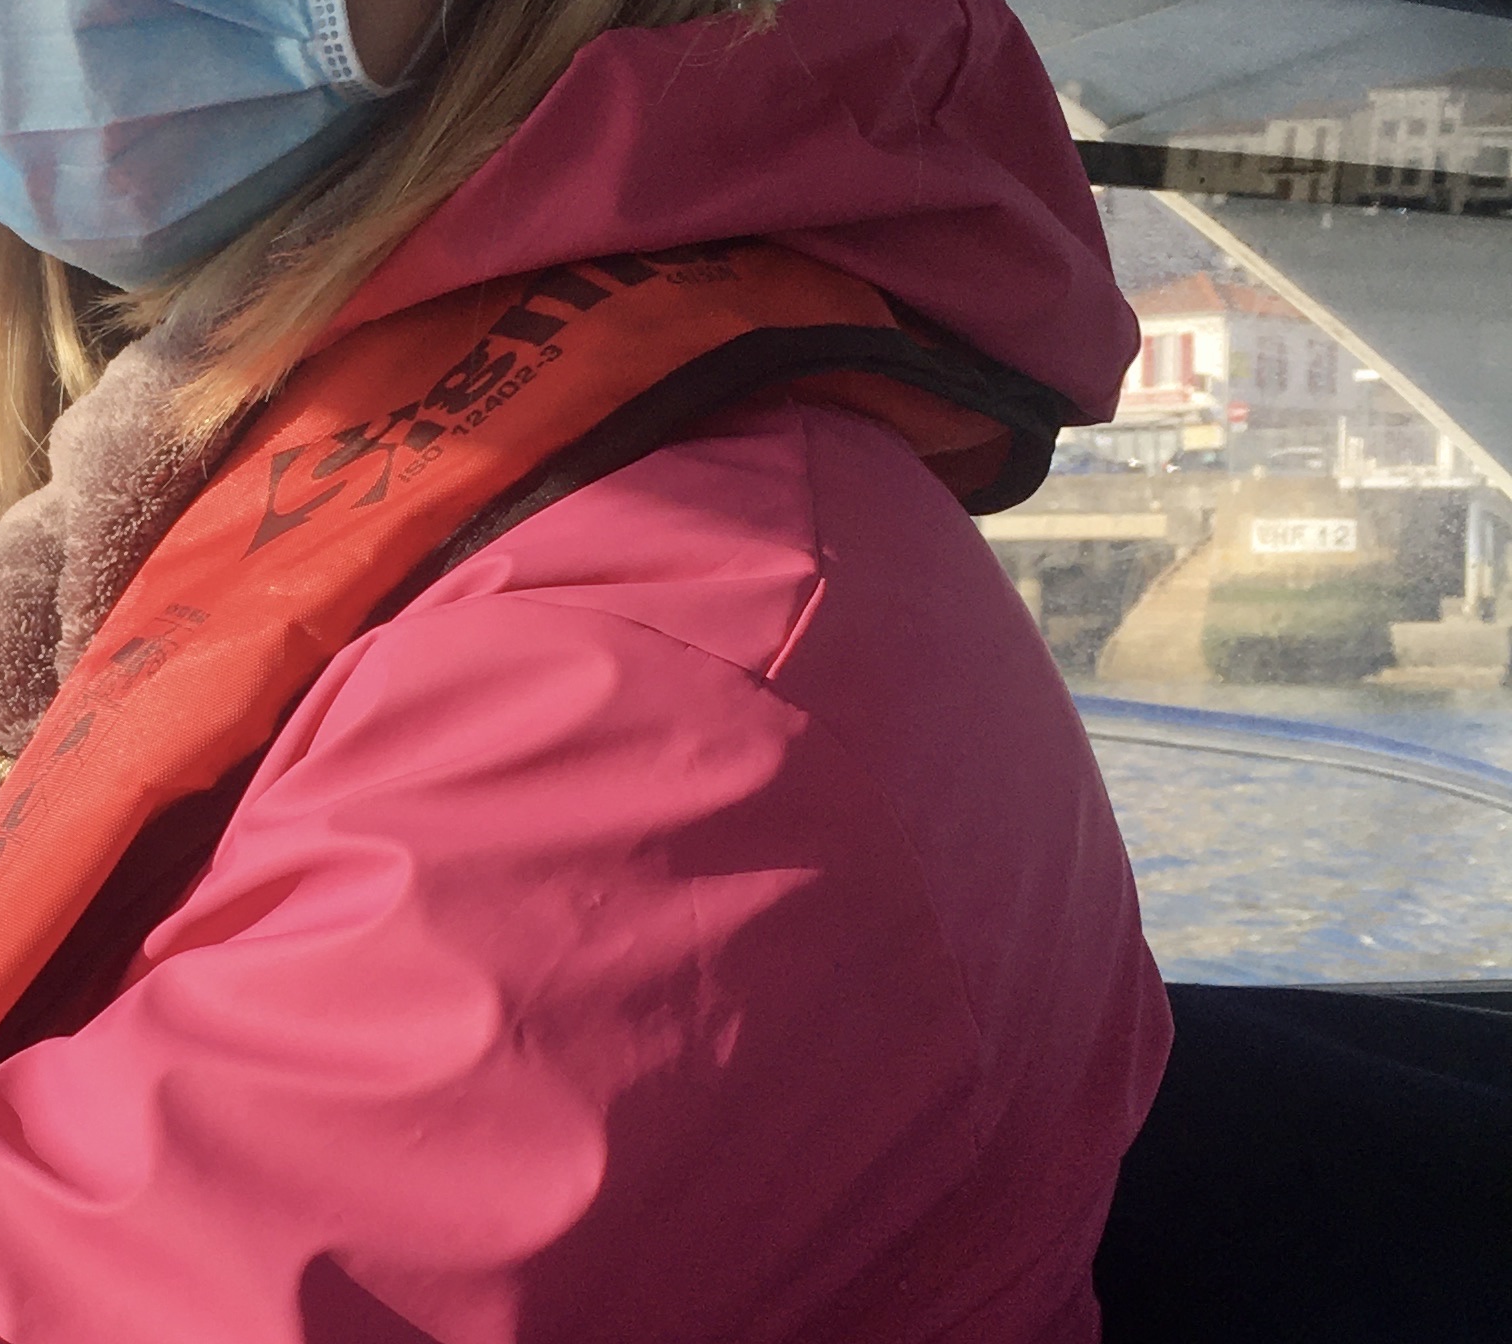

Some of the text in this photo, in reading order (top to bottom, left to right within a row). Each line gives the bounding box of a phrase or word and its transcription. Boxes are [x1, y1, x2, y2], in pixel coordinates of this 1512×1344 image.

[398, 343, 564, 484] ISO 12402-3
[1318, 524, 1350, 547] 12
